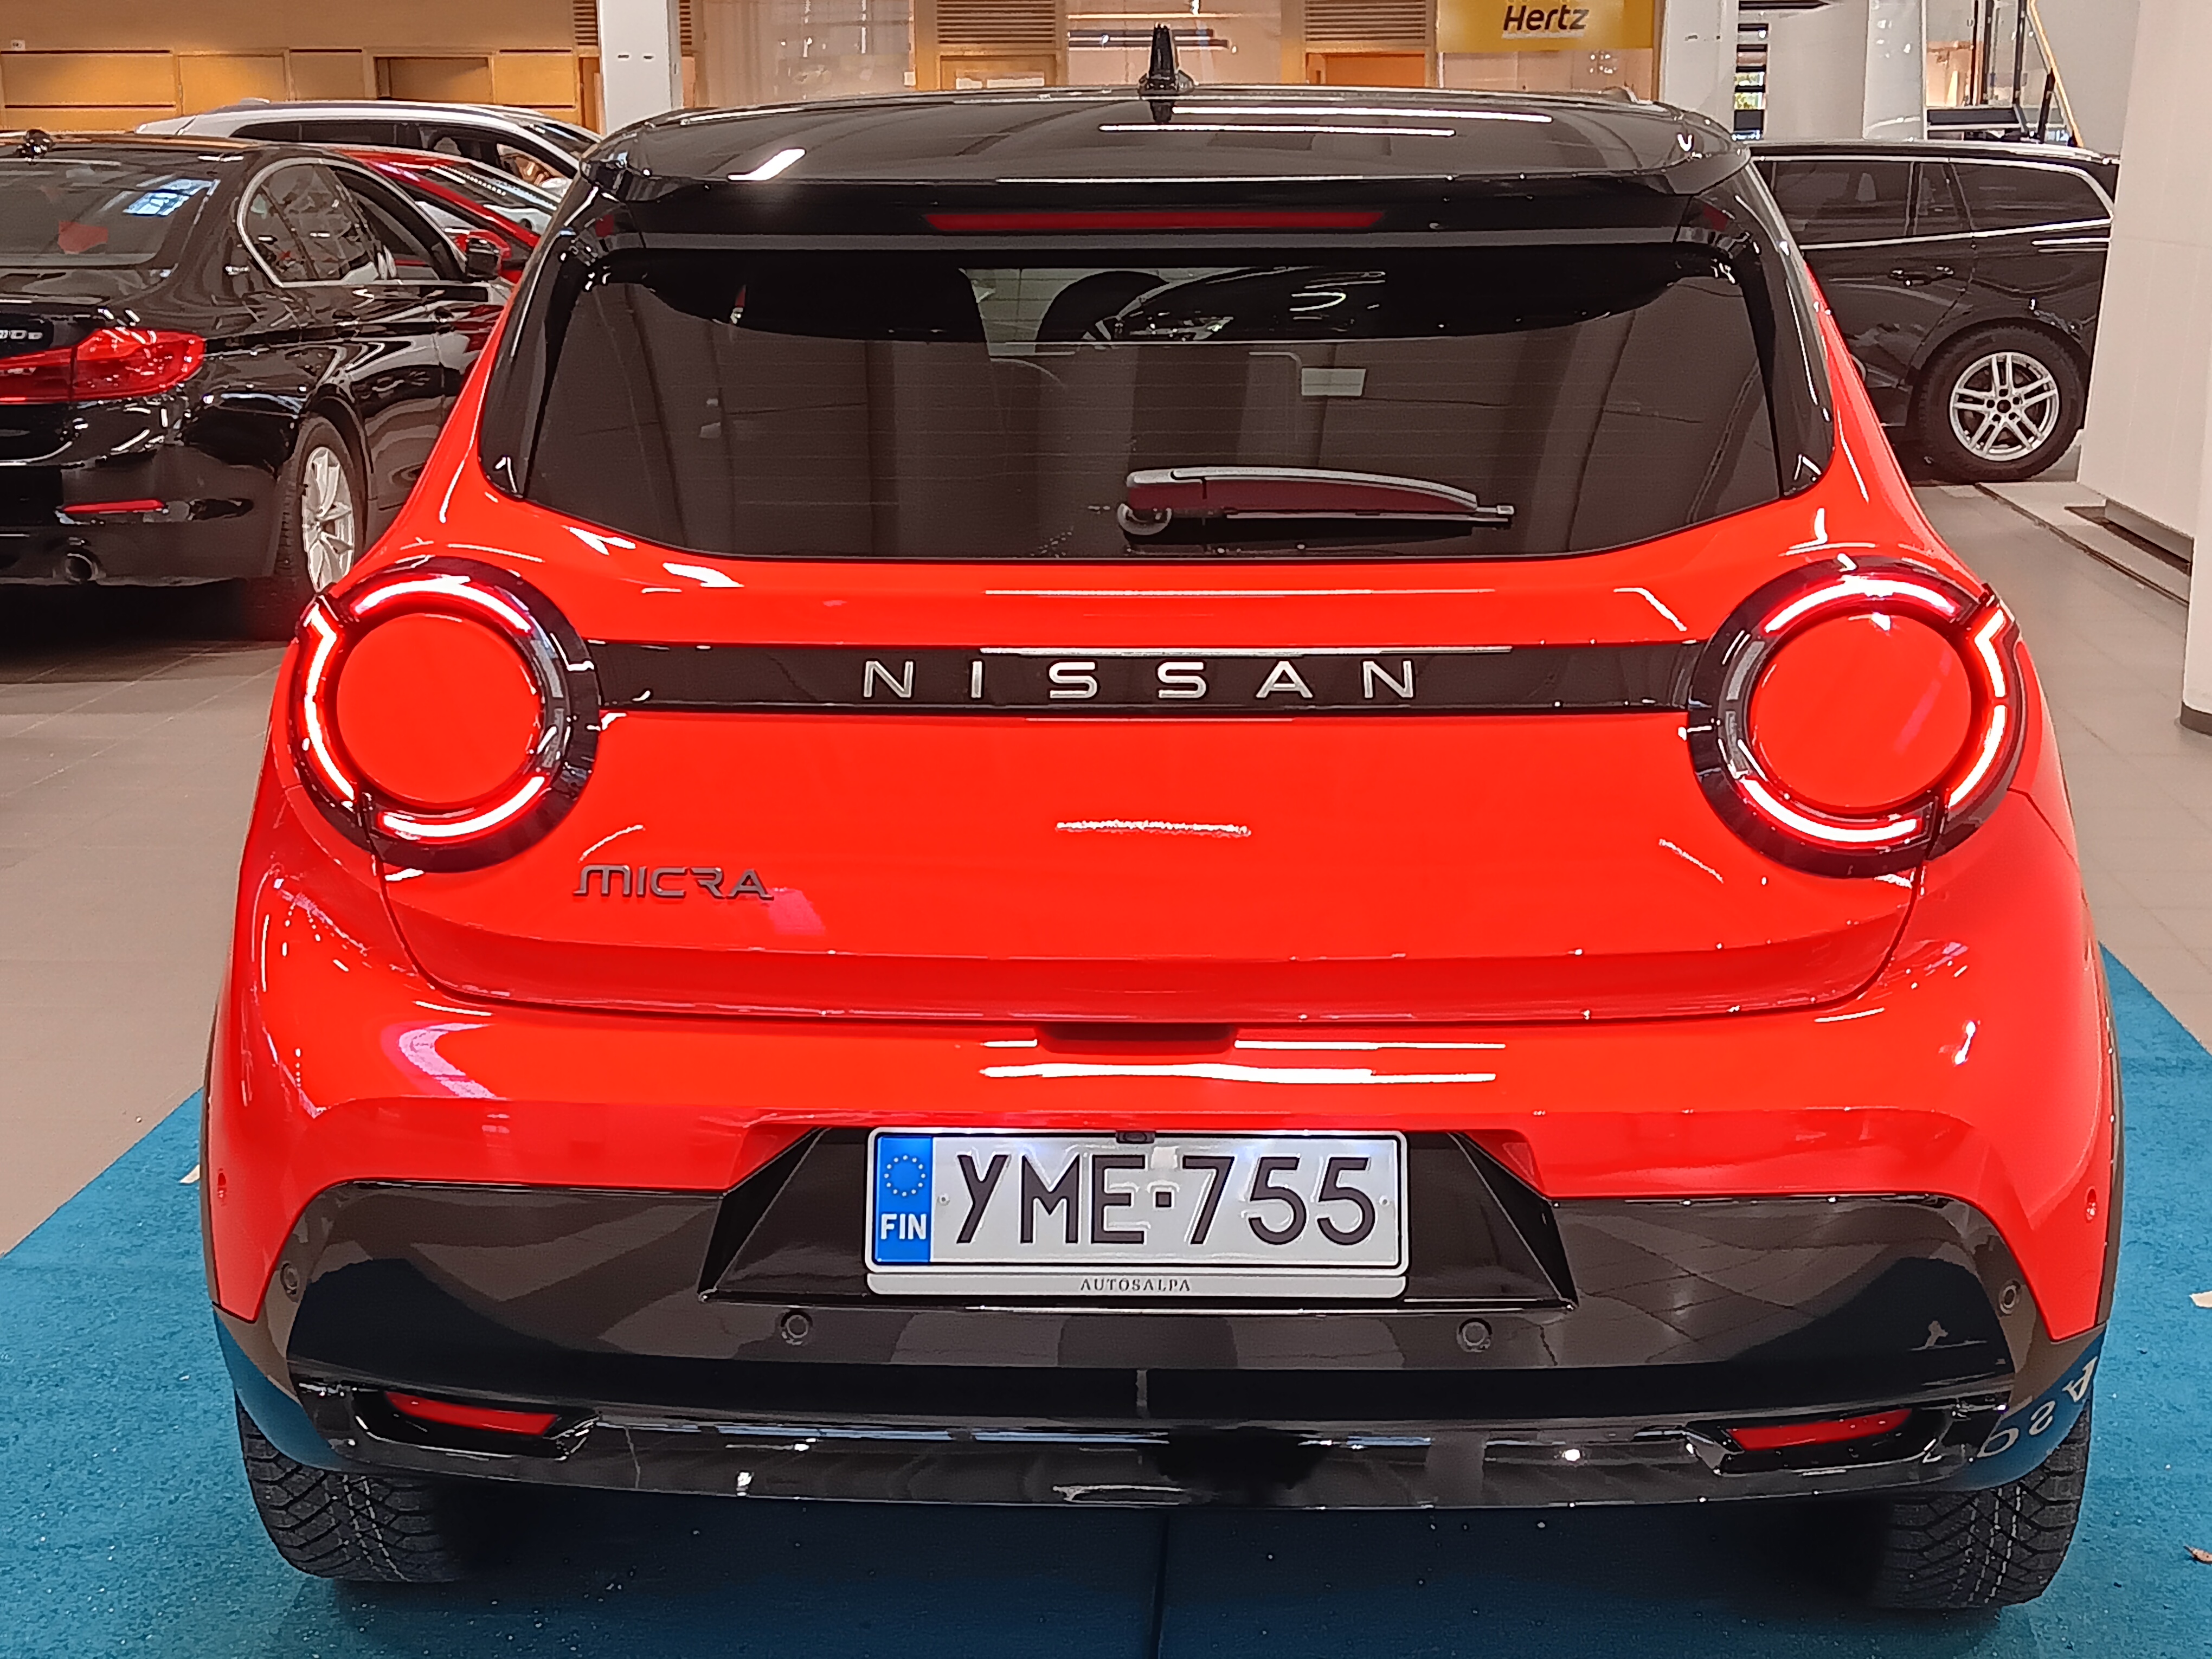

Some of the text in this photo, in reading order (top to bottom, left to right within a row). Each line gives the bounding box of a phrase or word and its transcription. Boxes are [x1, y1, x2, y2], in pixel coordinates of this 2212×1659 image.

[1503, 4, 1589, 30] Hertz
[863, 660, 1414, 699] NISSAN
[573, 864, 774, 900] MICRA
[880, 1213, 927, 1240] FIN
[1080, 1278, 1191, 1292] AUTOSALPA
